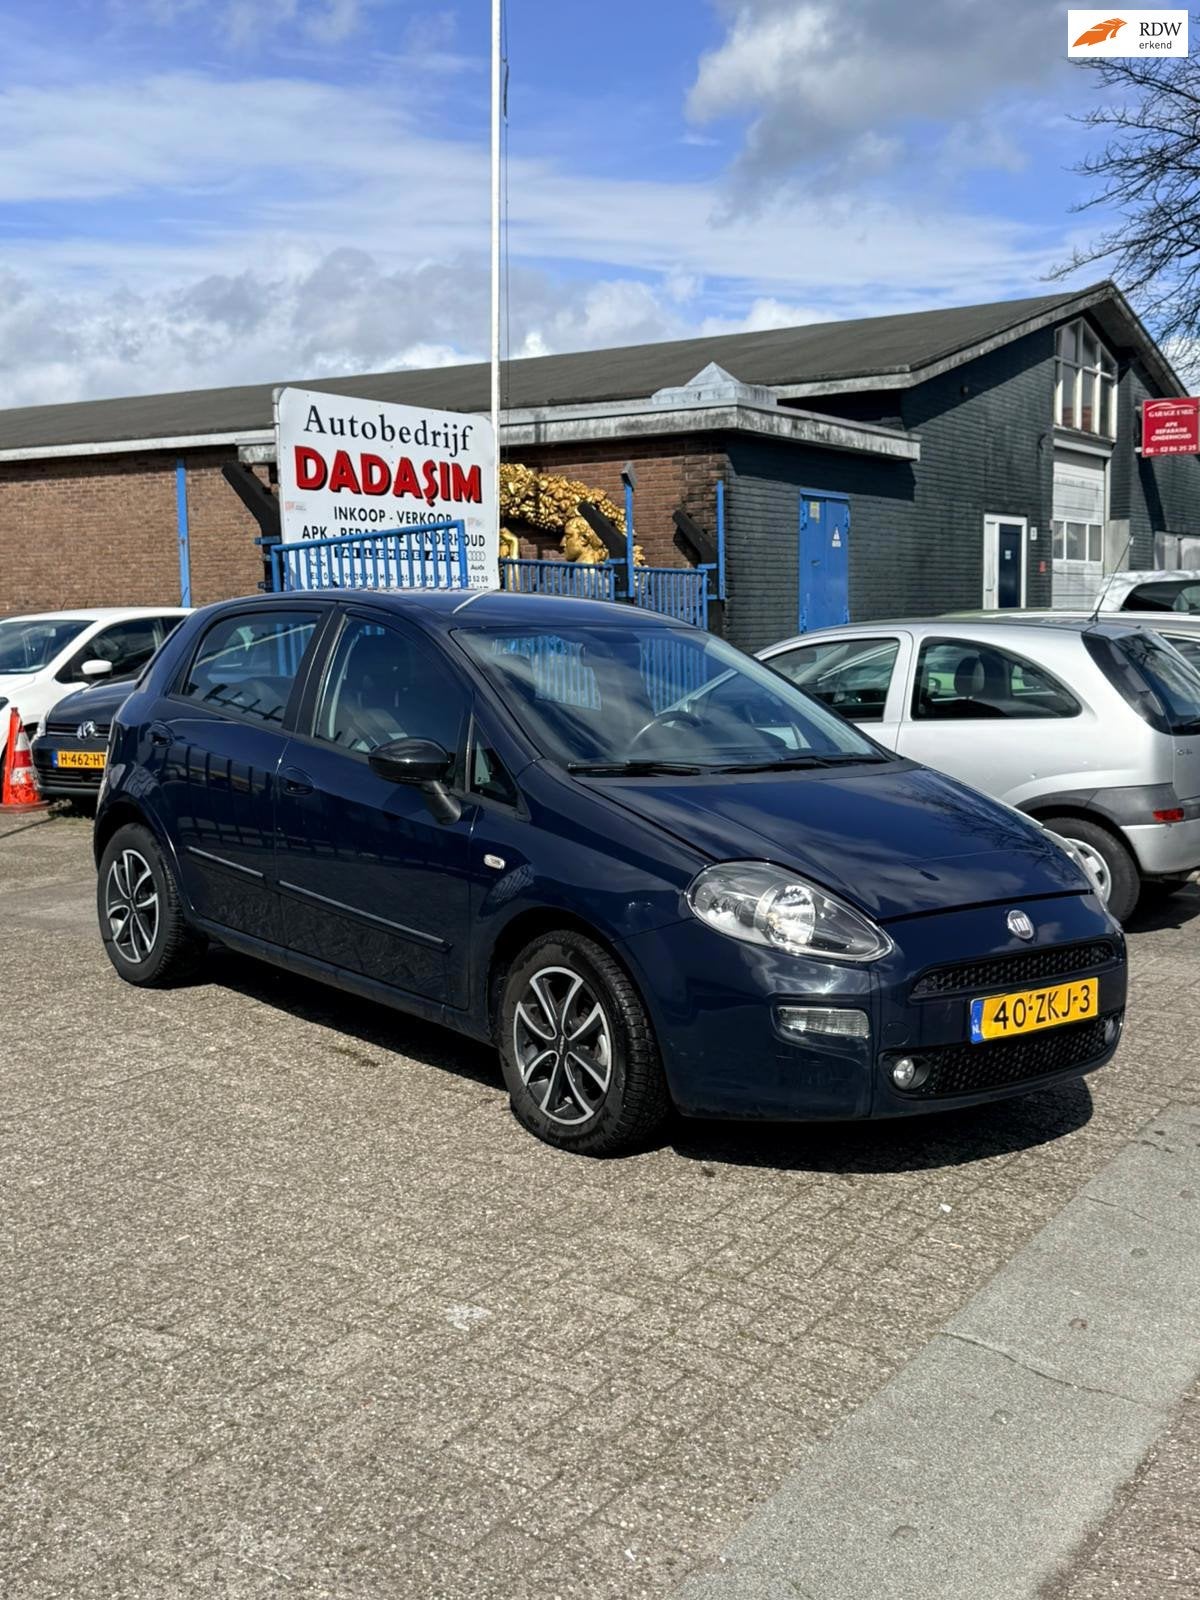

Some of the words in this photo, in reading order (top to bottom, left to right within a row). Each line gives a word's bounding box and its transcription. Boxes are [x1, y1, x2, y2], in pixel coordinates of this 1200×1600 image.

[303, 405, 473, 457] Autobedrijf
[294, 446, 482, 507] DADAŞIM
[302, 525, 328, 540] APK
[334, 506, 386, 523] INKOOP
[993, 984, 1090, 1030] 40-ZKJ-3
